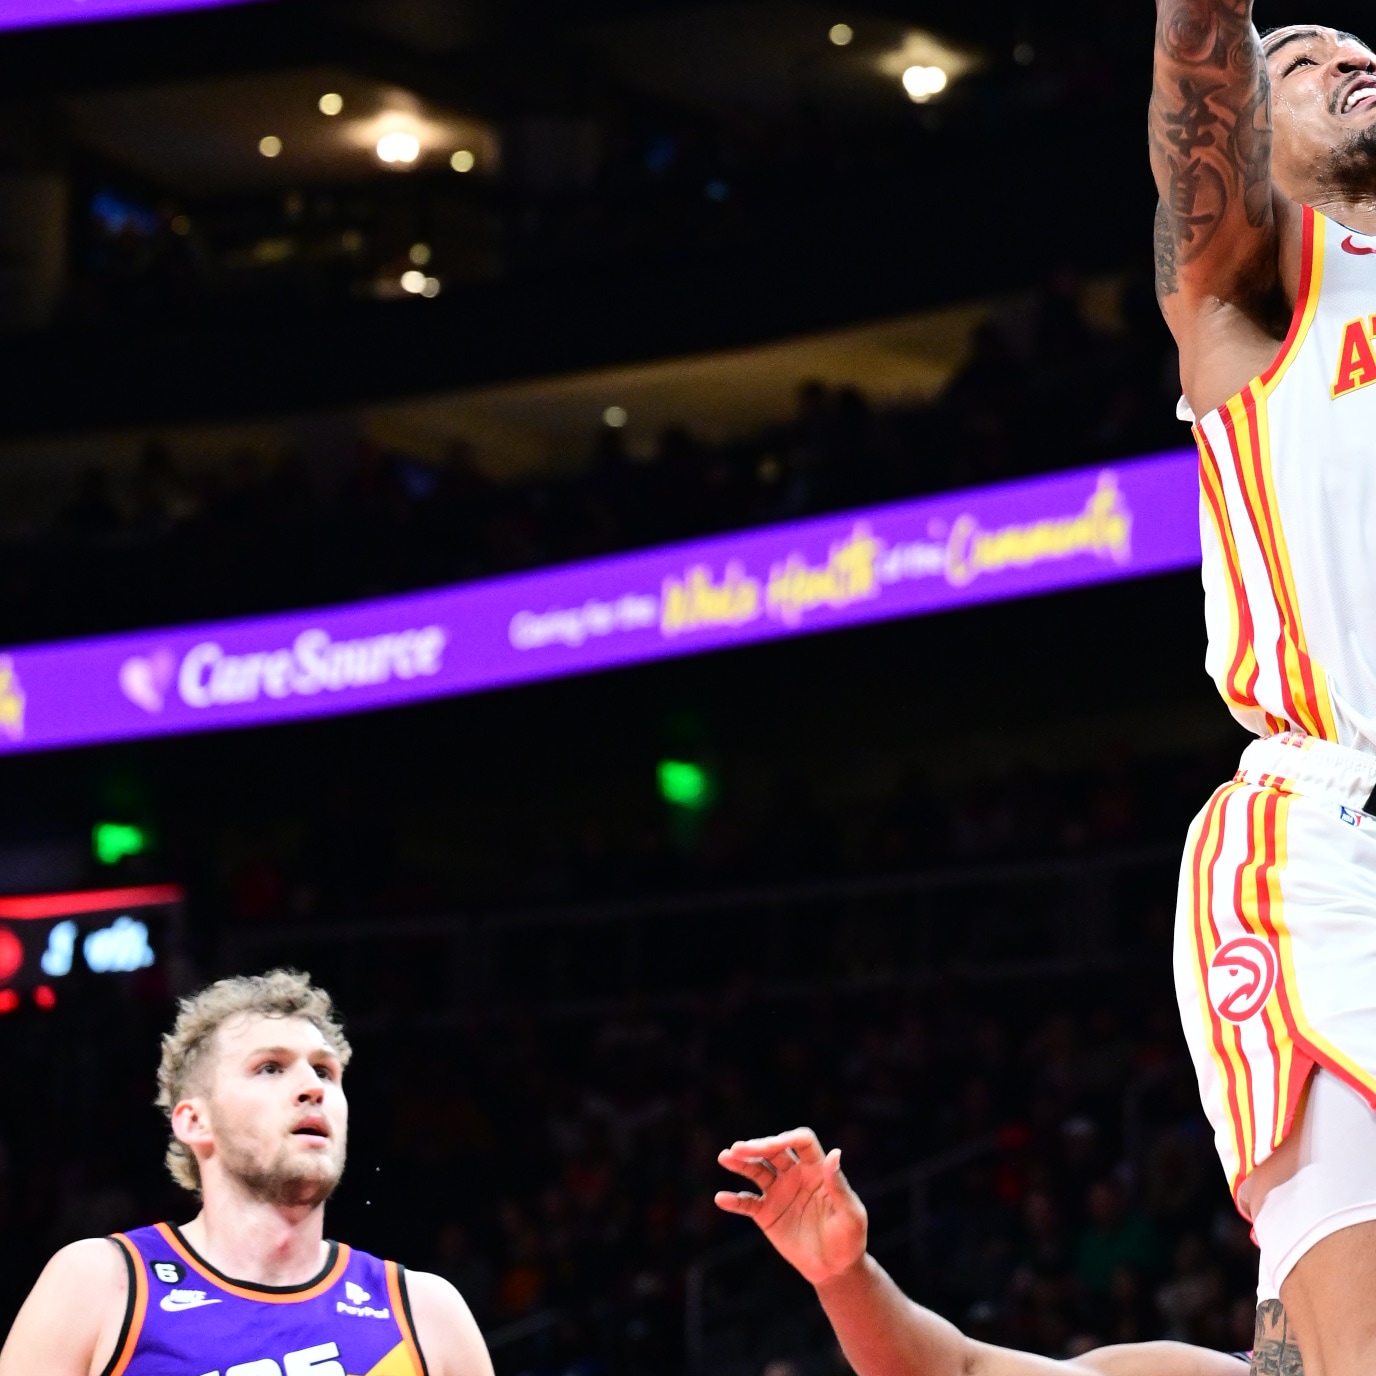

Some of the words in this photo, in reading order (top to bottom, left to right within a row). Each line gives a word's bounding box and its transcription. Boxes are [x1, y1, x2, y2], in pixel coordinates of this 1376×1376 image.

[177, 624, 447, 709] CareSource
[153, 1262, 180, 1285] 6
[336, 1301, 391, 1320] PayPal
